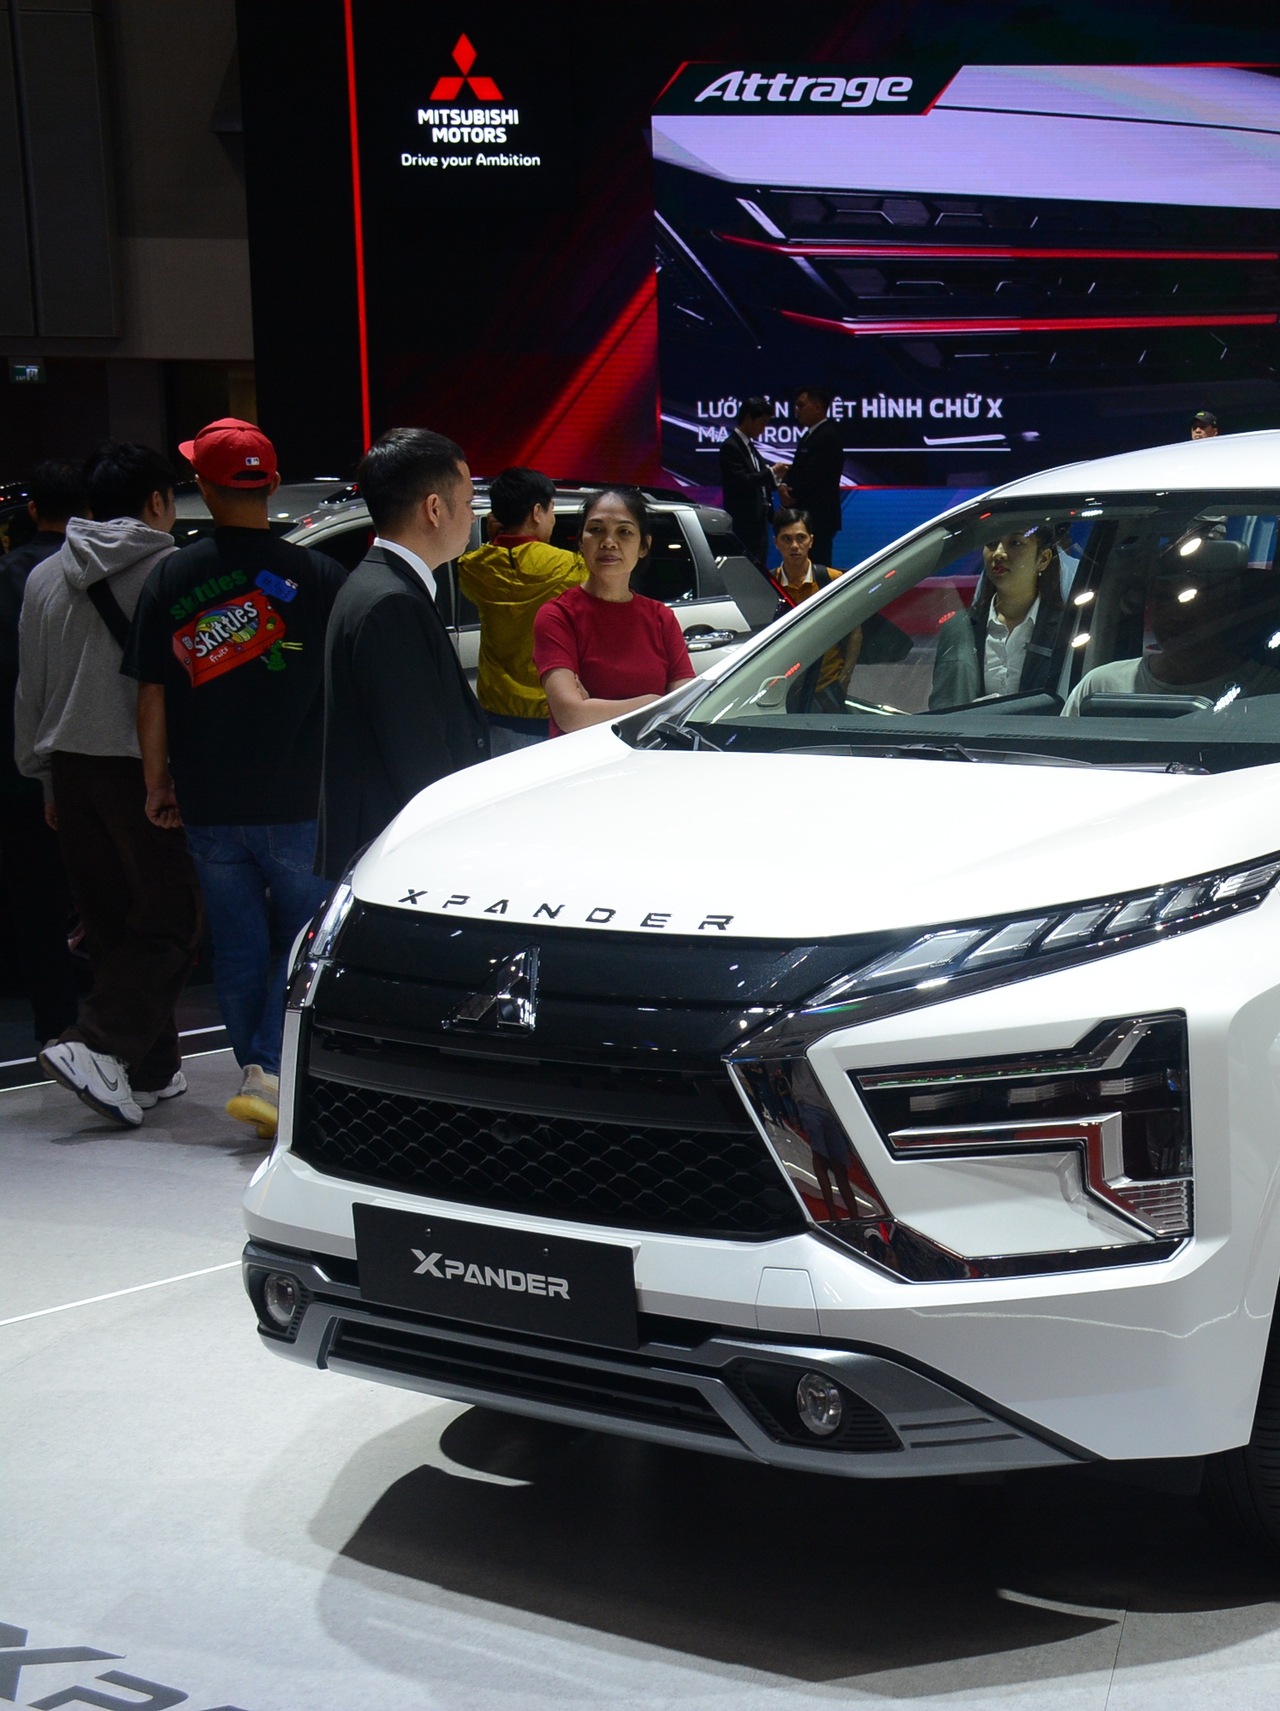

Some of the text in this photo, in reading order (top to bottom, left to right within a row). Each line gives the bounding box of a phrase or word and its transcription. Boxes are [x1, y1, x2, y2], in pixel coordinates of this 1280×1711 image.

[694, 70, 913, 108] Attrage
[417, 109, 519, 125] MITSUBISHI
[432, 127, 507, 143] MOTORS
[401, 153, 541, 169] Drive your Ambition
[862, 393, 922, 418] HÌNH
[929, 393, 981, 418] CHỮ
[986, 398, 1003, 418] X
[194, 601, 258, 657] Skittles
[398, 889, 735, 930] XPANDER
[410, 1248, 571, 1300] XPANDER
